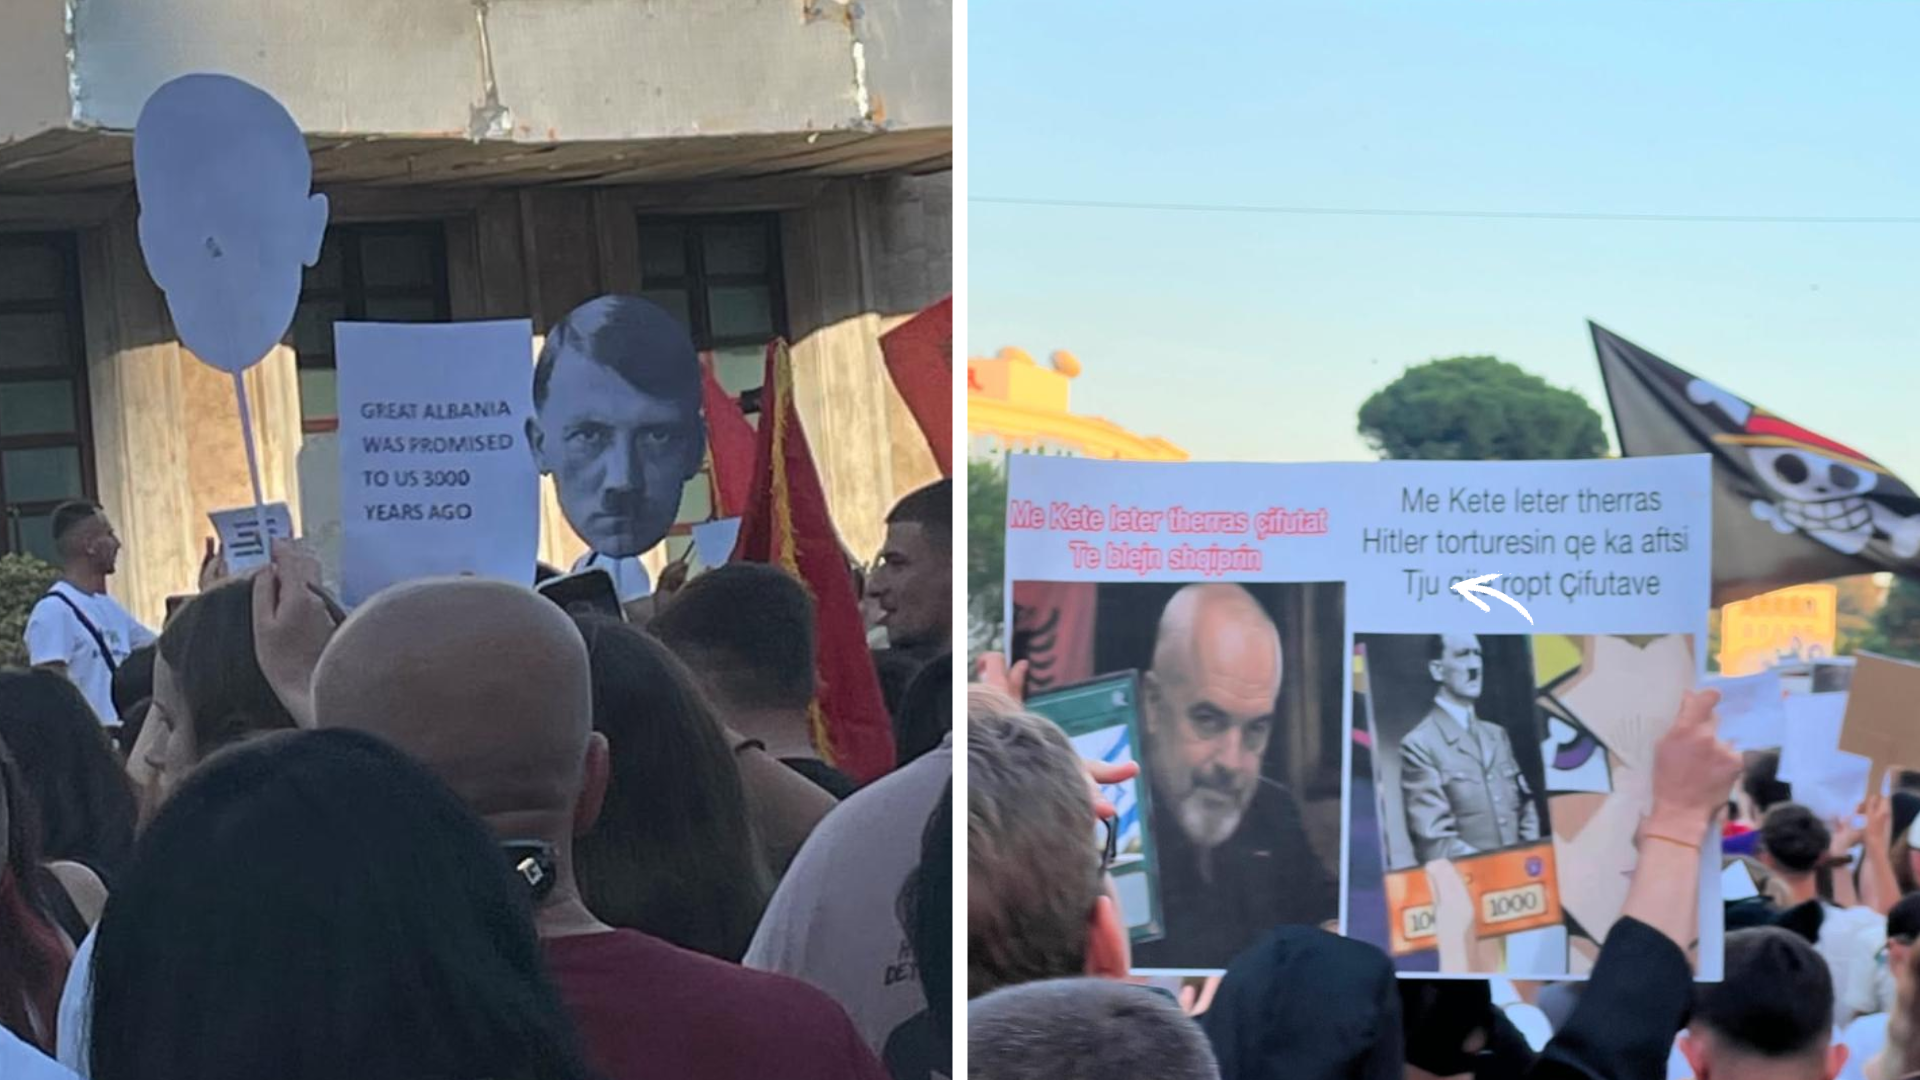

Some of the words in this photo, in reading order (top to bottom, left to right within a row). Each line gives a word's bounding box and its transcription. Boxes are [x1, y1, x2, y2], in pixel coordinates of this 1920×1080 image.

[360, 402, 418, 419] GREAT
[424, 401, 512, 418] ALBANIA
[362, 436, 405, 453] WAS
[409, 434, 514, 453] PROMISED
[363, 470, 389, 487] TO
[394, 470, 418, 487] US
[424, 469, 471, 487] 3000
[365, 504, 423, 521] YEARS
[429, 503, 473, 520] AGO
[1402, 487, 1440, 513] Me
[1450, 487, 1506, 513] Kete
[1515, 488, 1569, 513] leter
[1578, 488, 1662, 513] therras
[1010, 500, 1044, 529] Me
[1050, 502, 1104, 531] Kete
[1109, 505, 1163, 532] leter
[1168, 506, 1249, 533] therras
[1255, 508, 1328, 540] çifutat
[1363, 528, 1428, 554] Hitler
[1437, 528, 1555, 555] torturesin
[1565, 533, 1596, 560] qe
[1605, 526, 1633, 554] ka
[1642, 525, 1690, 552] aftsi
[1069, 541, 1101, 569] Te
[1106, 542, 1162, 575] blejn
[1402, 569, 1440, 601] Tju
[1560, 571, 1661, 603] Çifutave
[1490, 892, 1538, 917] 1000
